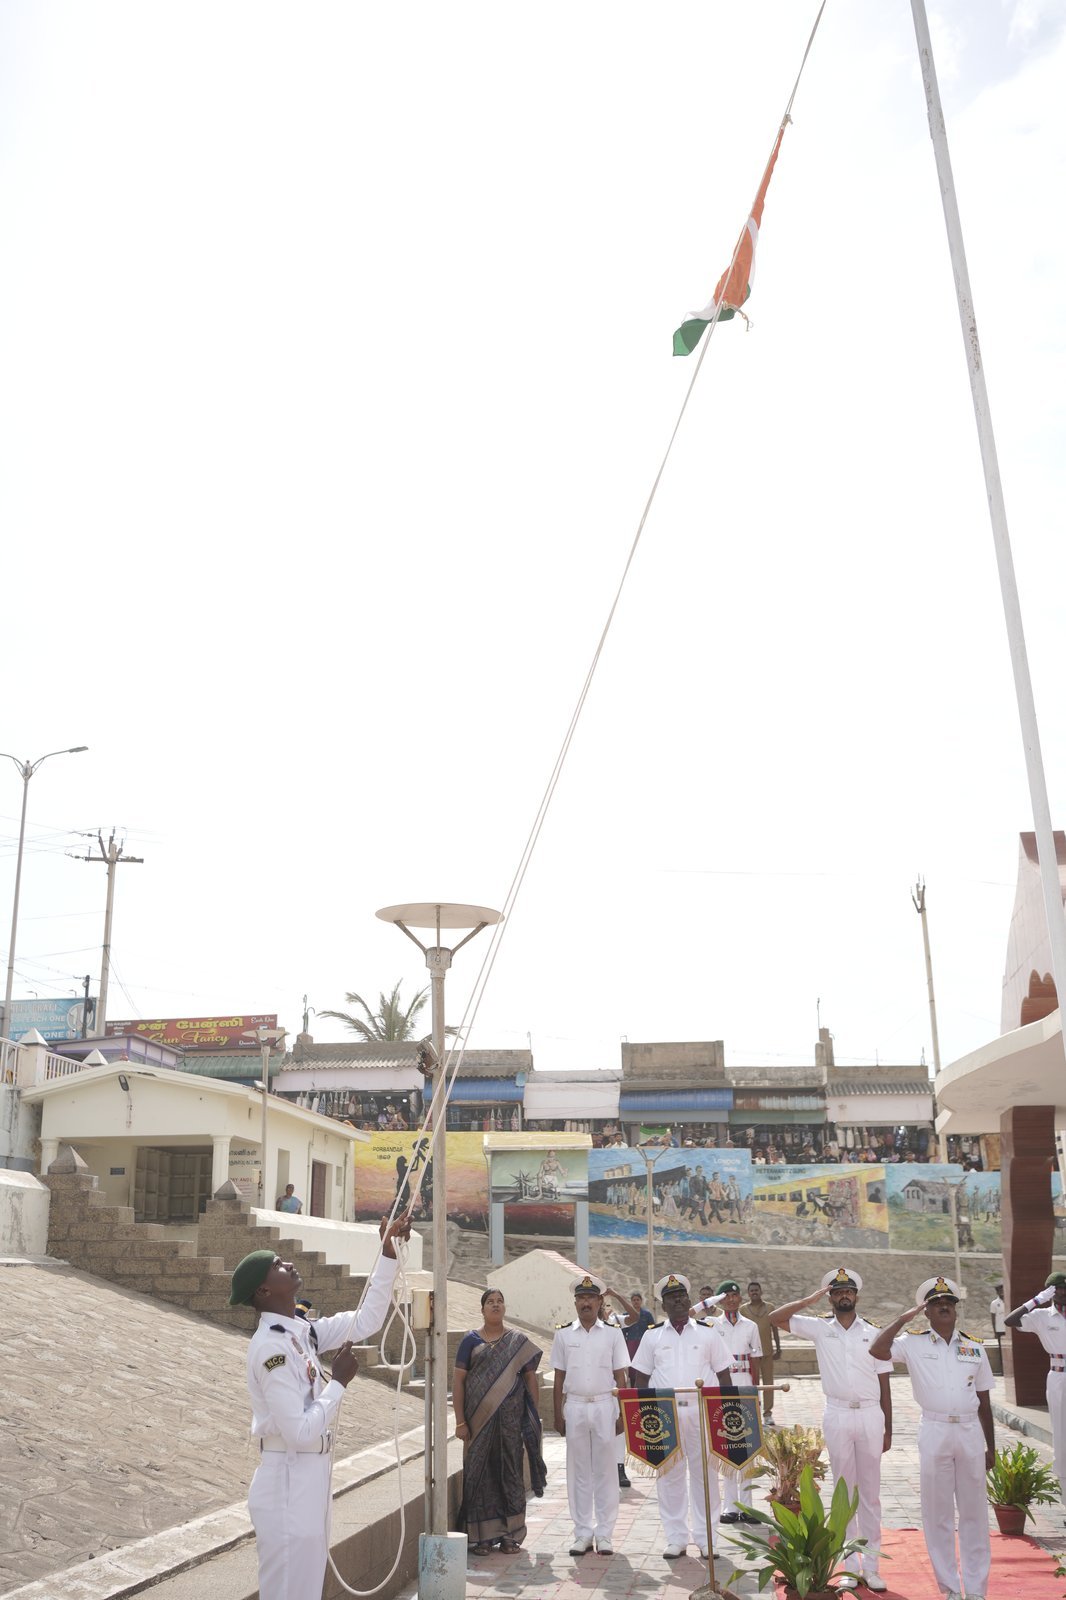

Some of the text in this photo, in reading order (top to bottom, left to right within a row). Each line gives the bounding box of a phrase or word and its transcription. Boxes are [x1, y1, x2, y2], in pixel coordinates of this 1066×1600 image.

[181, 1029, 230, 1046] Fancy
[267, 1356, 284, 1368] NCC
[721, 1442, 753, 1450] TUTICORIN
